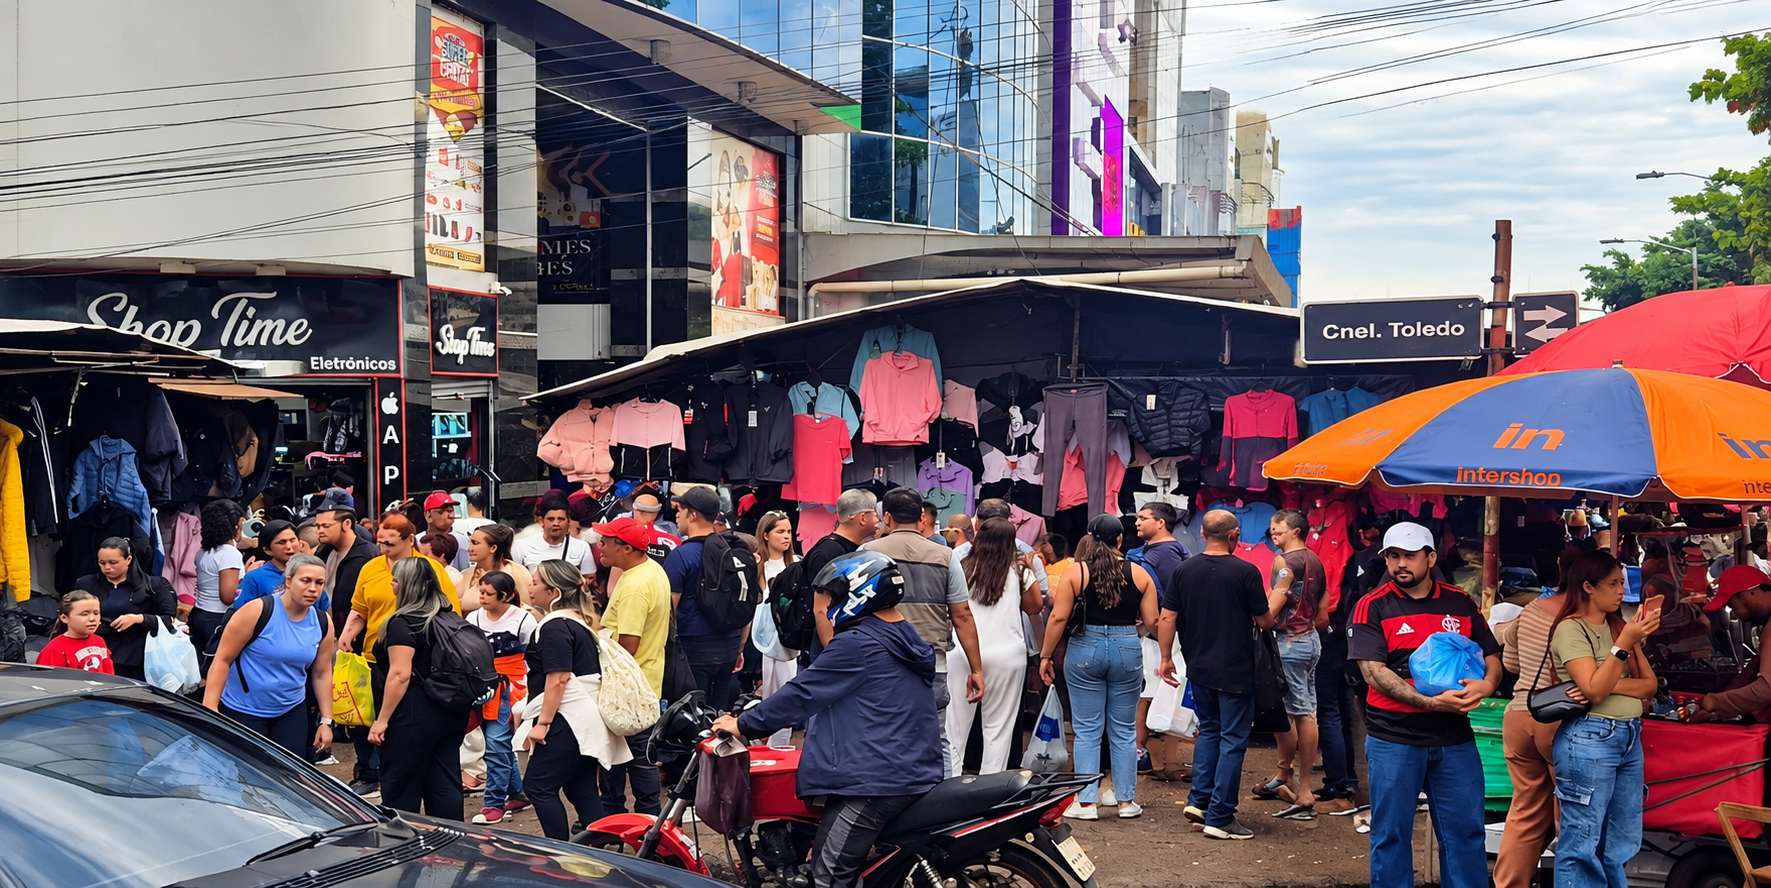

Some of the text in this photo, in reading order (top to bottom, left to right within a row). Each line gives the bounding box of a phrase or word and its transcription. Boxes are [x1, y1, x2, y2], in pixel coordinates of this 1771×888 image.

[211, 291, 312, 347] Time
[1322, 320, 1465, 340] Cnel. Toledo
[1492, 422, 1565, 450] in
[1456, 466, 1561, 487] intershop
